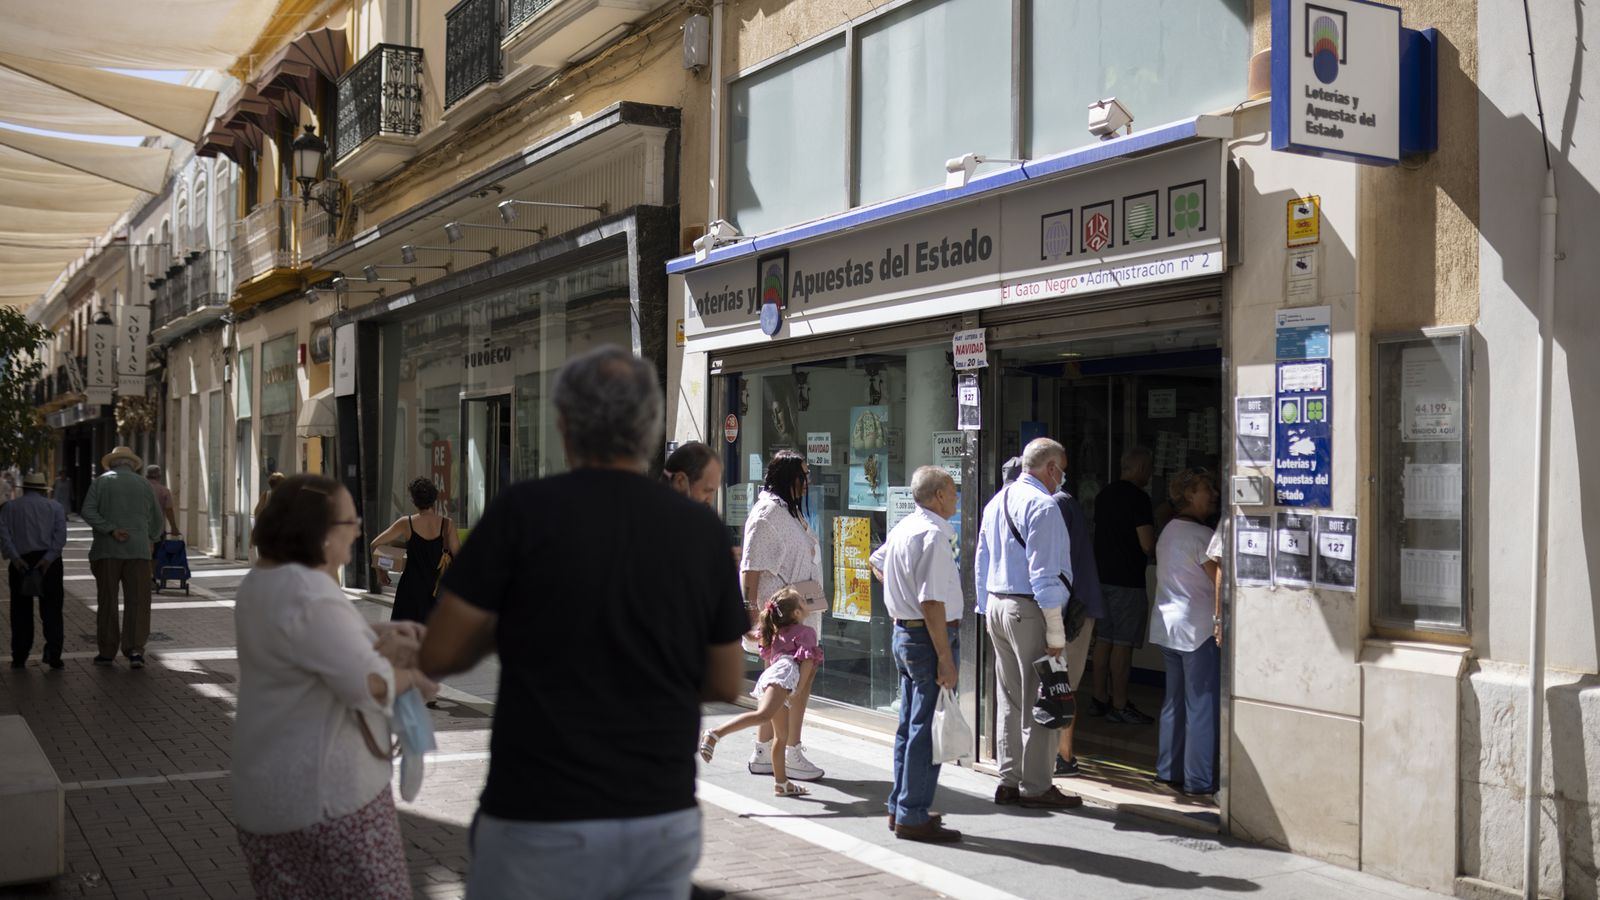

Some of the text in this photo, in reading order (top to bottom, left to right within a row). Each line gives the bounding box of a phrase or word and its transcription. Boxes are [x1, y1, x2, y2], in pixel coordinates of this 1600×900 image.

[1305, 85, 1359, 110] Loterías y
[1306, 103, 1376, 127] Apuestas del
[1306, 121, 1344, 139] Estado
[792, 228, 993, 302] Apuestas del Estado
[1002, 284, 1011, 299] El
[1015, 283, 1040, 297] Gato
[1086, 259, 1174, 286] Administración
[1202, 252, 1210, 268] 2
[689, 285, 756, 319] Loterías y
[128, 315, 140, 373] NOVIAS
[955, 342, 984, 355] NAVIDAD
[94, 333, 105, 385] NOVIAS
[464, 345, 512, 369] PUROEGO
[967, 358, 976, 367] 20
[1416, 403, 1447, 413] 44.199
[434, 446, 445, 467] RE
[808, 444, 829, 453] NAVIDAD
[1310, 460, 1317, 471] y
[1277, 473, 1329, 487] Apuestas del
[1277, 489, 1304, 500] Estado
[1329, 520, 1344, 531] BOTE
[1288, 538, 1298, 548] 31
[1328, 543, 1345, 552] 127
